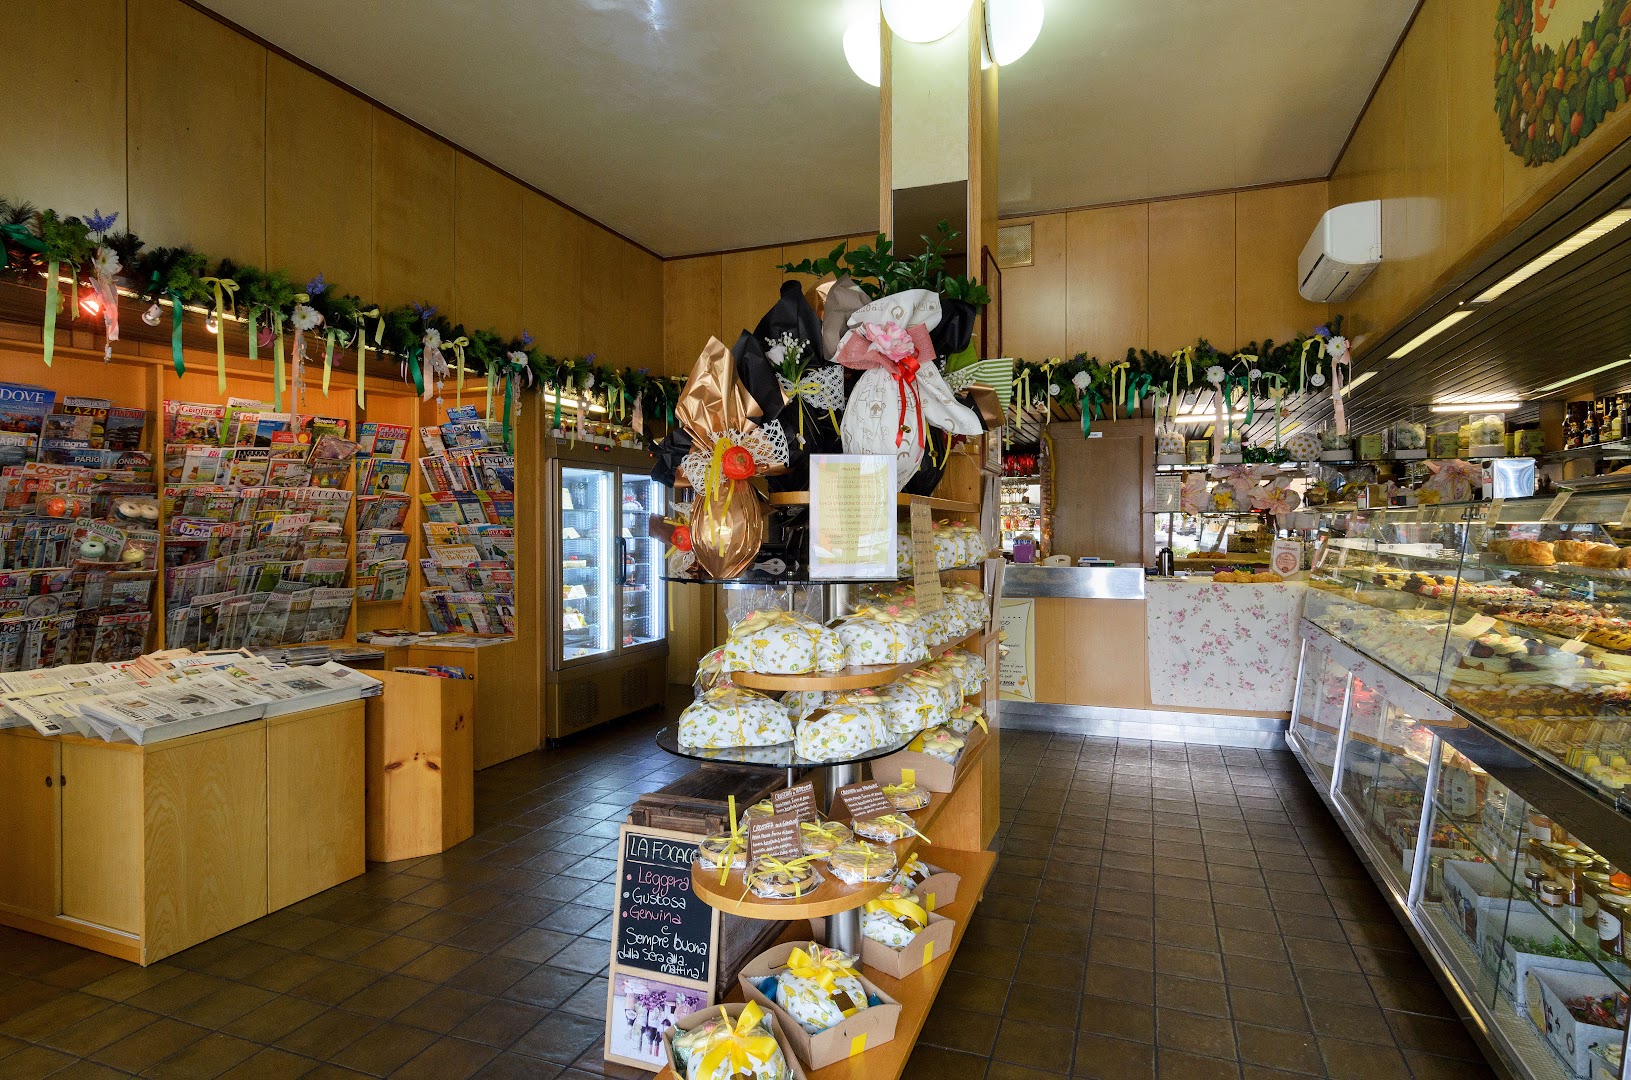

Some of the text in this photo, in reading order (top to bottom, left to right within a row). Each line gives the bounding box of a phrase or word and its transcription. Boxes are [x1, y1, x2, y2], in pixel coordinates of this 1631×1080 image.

[0, 388, 45, 404] DOVE
[64, 406, 107, 416] LAZIO
[35, 466, 72, 477] Casa
[630, 836, 649, 858] LA
[637, 866, 690, 897] Leggera
[632, 887, 686, 909] Gustosa
[629, 905, 683, 925] Genuina
[661, 924, 671, 936] e
[625, 926, 708, 956] Sempre buona
[641, 948, 665, 963] Sera
